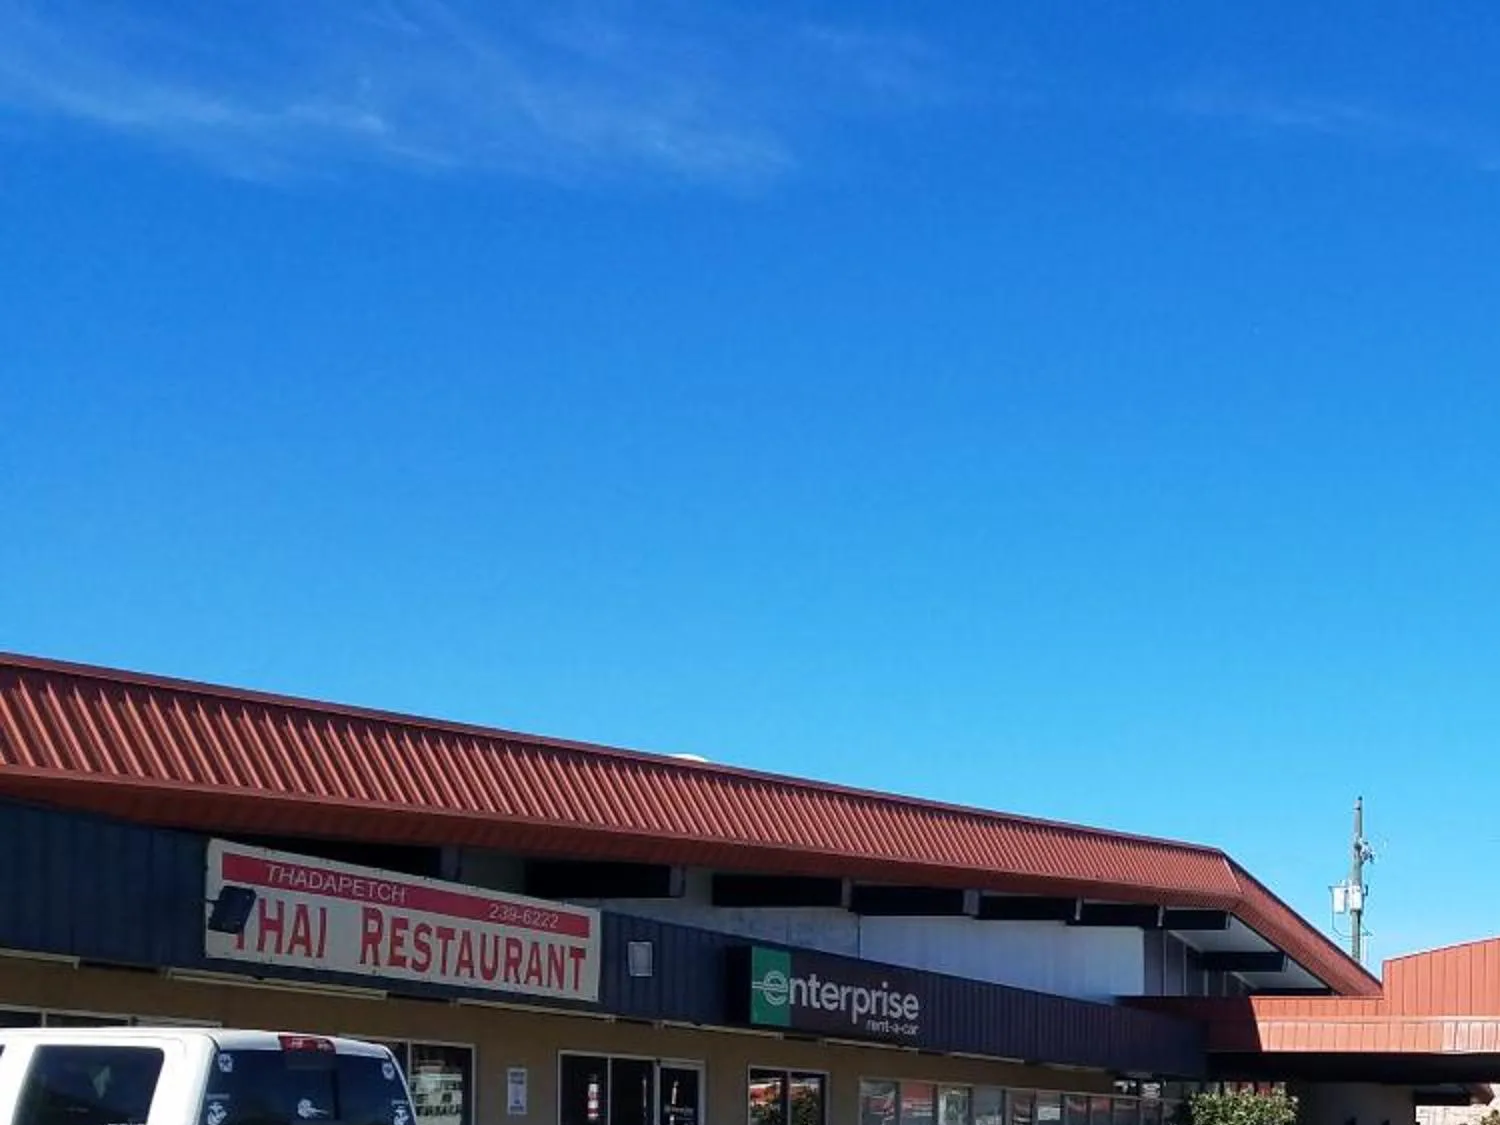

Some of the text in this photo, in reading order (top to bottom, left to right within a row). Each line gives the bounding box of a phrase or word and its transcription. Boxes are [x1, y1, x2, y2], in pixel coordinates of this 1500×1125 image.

[266, 863, 406, 903] THADAPETCH
[359, 906, 586, 991] RESTAURANT
[763, 970, 919, 1025] enterprise
[866, 1019, 919, 1036] rent-a-car
